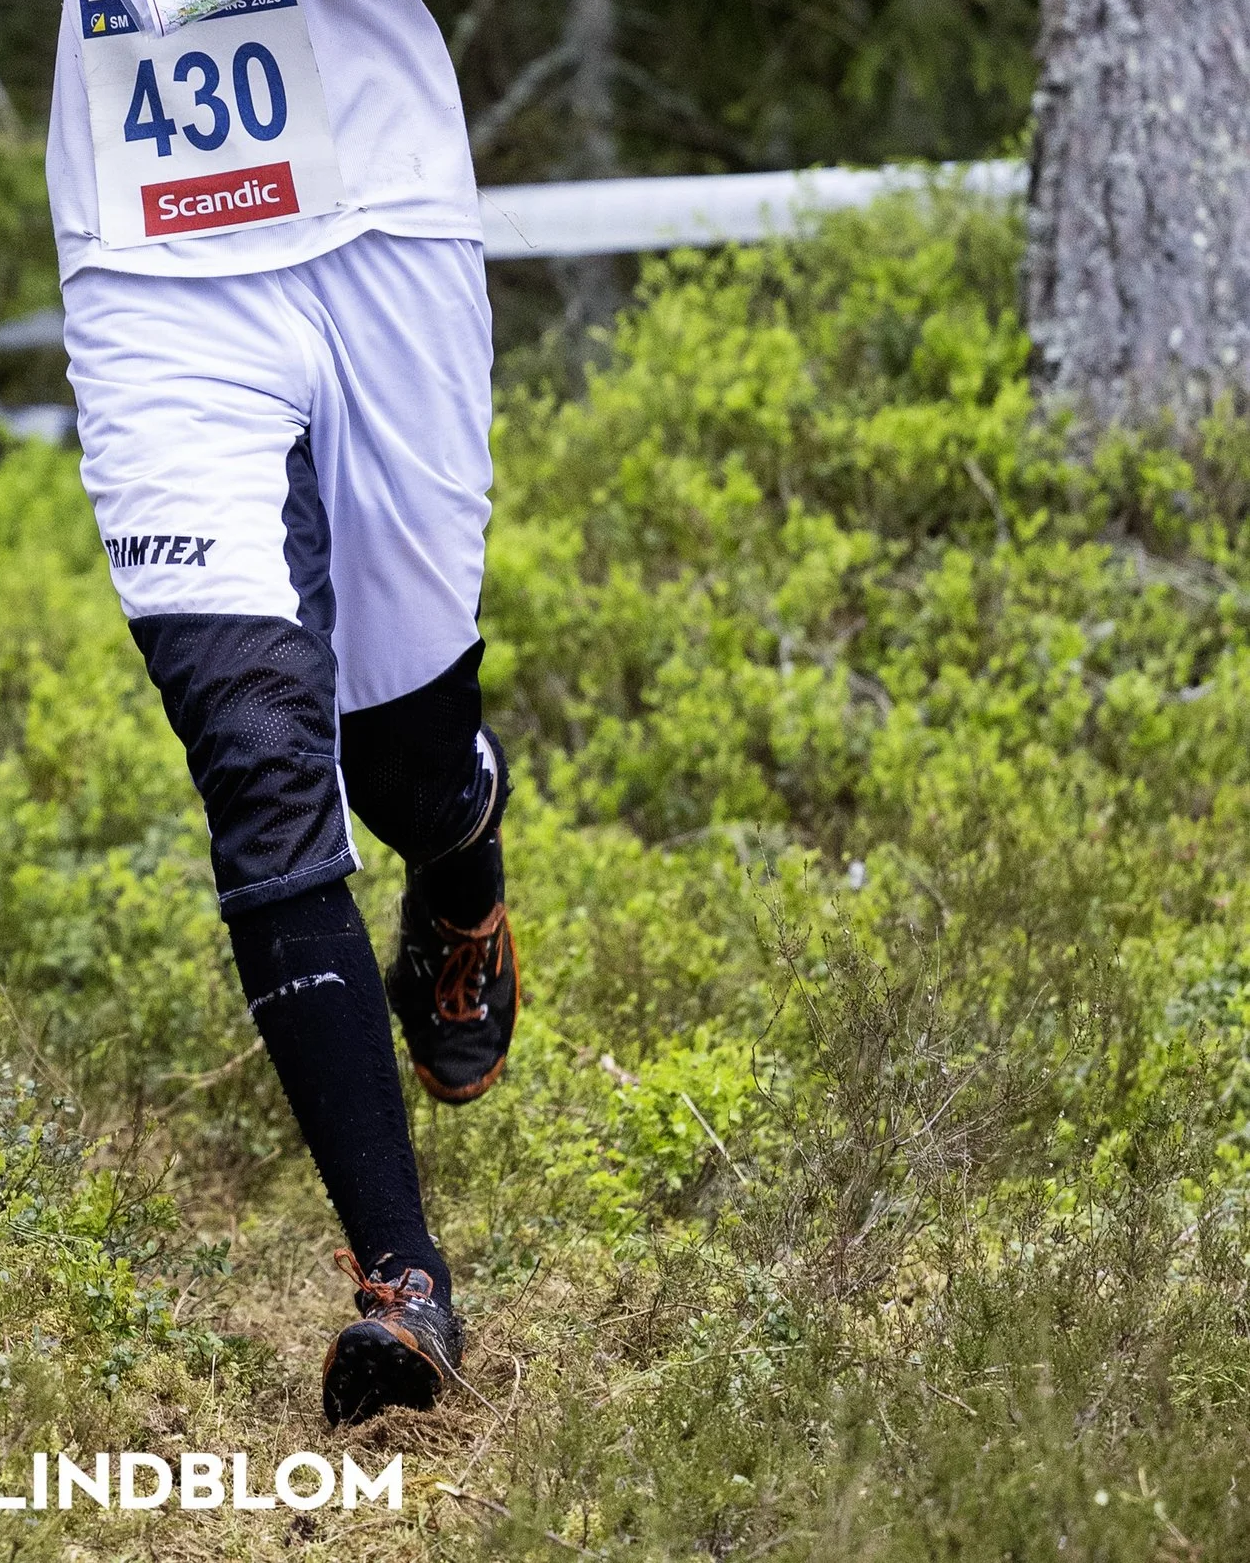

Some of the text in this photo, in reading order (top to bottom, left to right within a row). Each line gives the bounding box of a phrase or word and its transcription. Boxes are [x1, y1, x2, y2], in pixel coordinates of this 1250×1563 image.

[110, 15, 129, 29] SM
[124, 41, 287, 157] 430
[158, 179, 280, 220] Scandic
[105, 535, 216, 569] TRIMTEX
